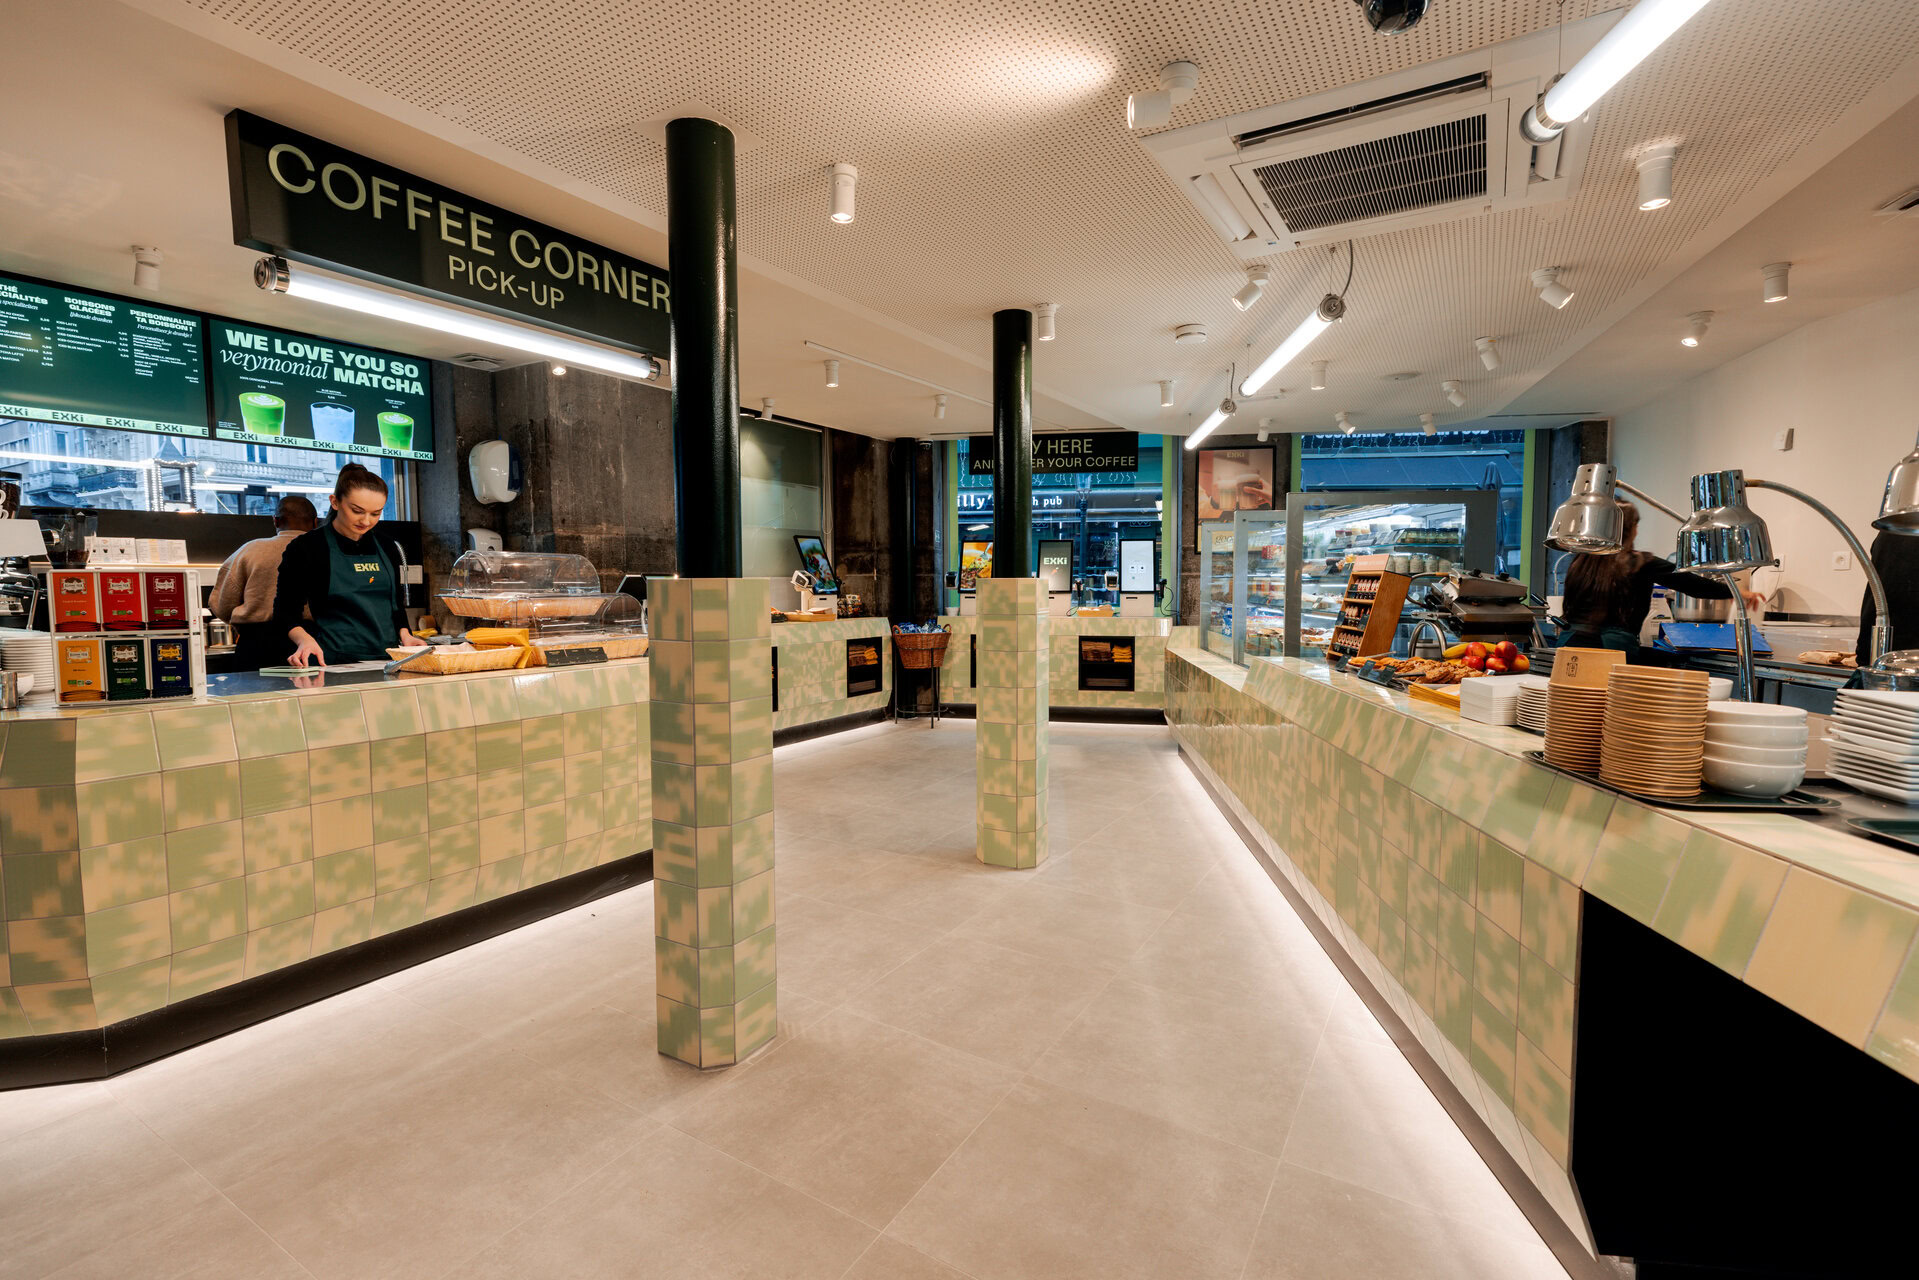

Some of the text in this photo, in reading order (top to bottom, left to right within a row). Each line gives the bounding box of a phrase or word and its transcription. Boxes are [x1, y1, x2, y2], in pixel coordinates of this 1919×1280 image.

[267, 143, 671, 314] COFFEE CORNER
[447, 254, 565, 310] PICK-UP
[64, 297, 116, 312] BOISSONS
[129, 309, 197, 327] PERSONNALISE
[135, 316, 147, 324] TA
[148, 318, 188, 332] BOISSON
[225, 329, 419, 379] WE LOVE YOU SO
[219, 349, 328, 380] verymonial
[333, 367, 425, 396] MATCHA
[52, 412, 84, 422] EXKi
[106, 417, 135, 428] EXKi
[155, 423, 183, 433] EXKi
[233, 432, 433, 460] EXKi EXKi EXKi EXKi EXKi EXKi
[1047, 439, 1093, 454] HERE
[973, 459, 994, 470] AN
[1048, 457, 1082, 468] YOUR
[1085, 456, 1135, 467] COFFEE
[1043, 495, 1062, 508] pub
[1043, 557, 1067, 565] EXKi
